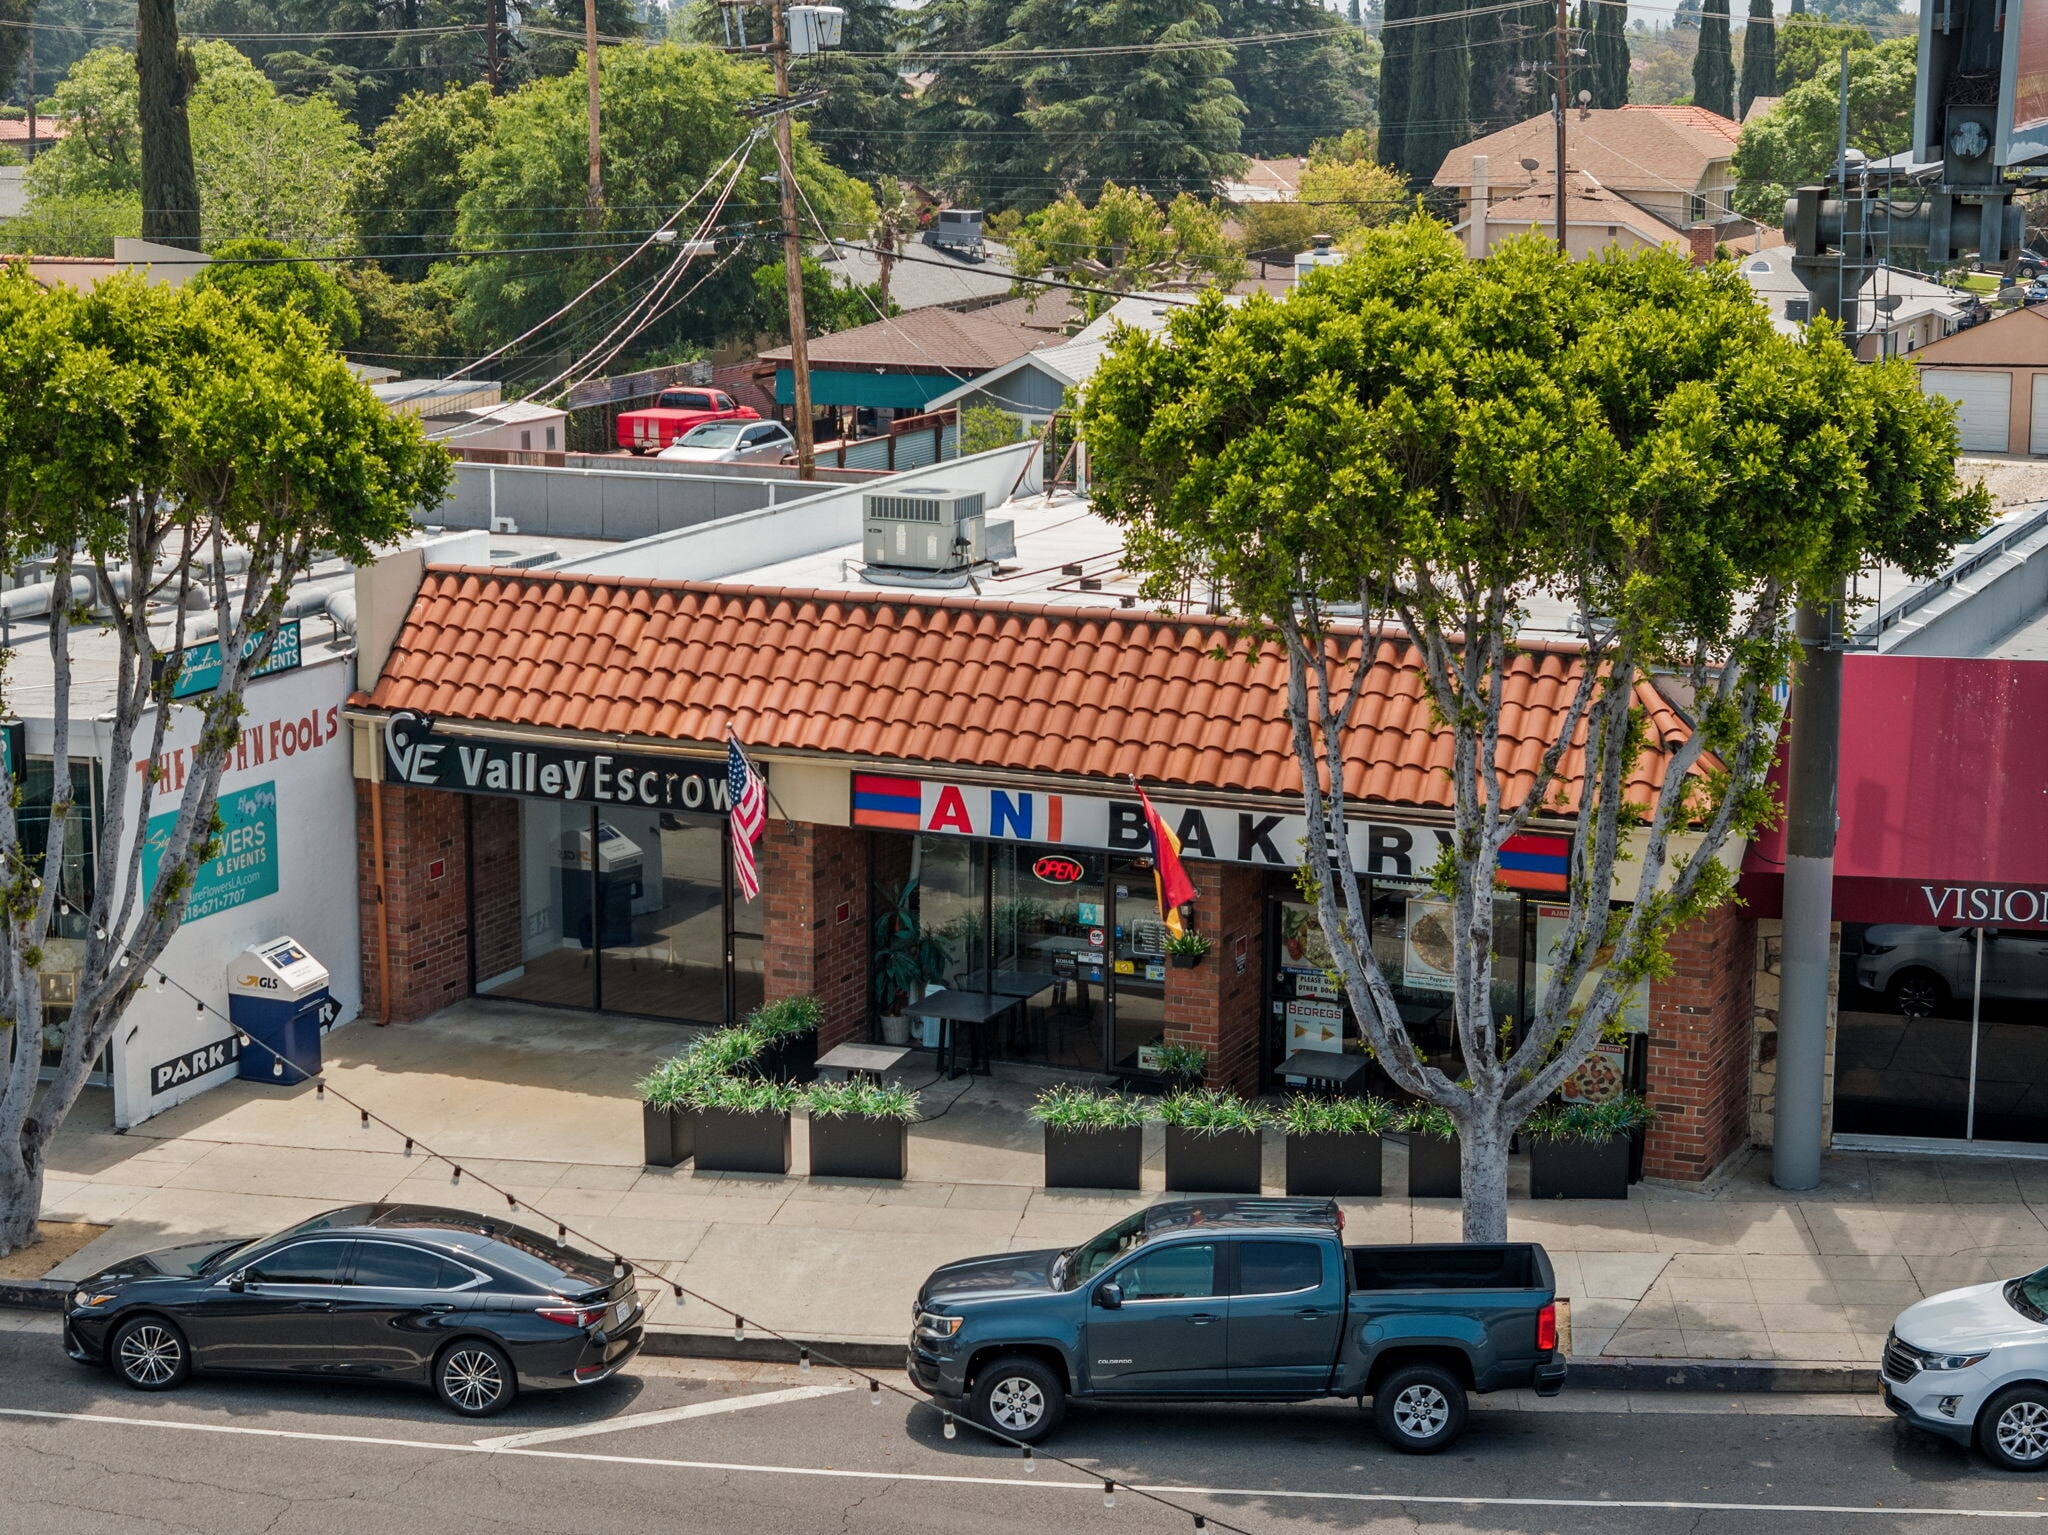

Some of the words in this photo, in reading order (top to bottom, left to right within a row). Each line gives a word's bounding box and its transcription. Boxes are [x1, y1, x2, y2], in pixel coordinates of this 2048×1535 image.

[269, 704, 338, 762] FOOLS
[458, 746, 588, 800] Valley
[927, 785, 1063, 842] ANI
[226, 847, 267, 874] EVENTS
[1036, 860, 1081, 880] OPEN
[259, 977, 278, 989] GLS
[158, 1043, 225, 1088] PARK
